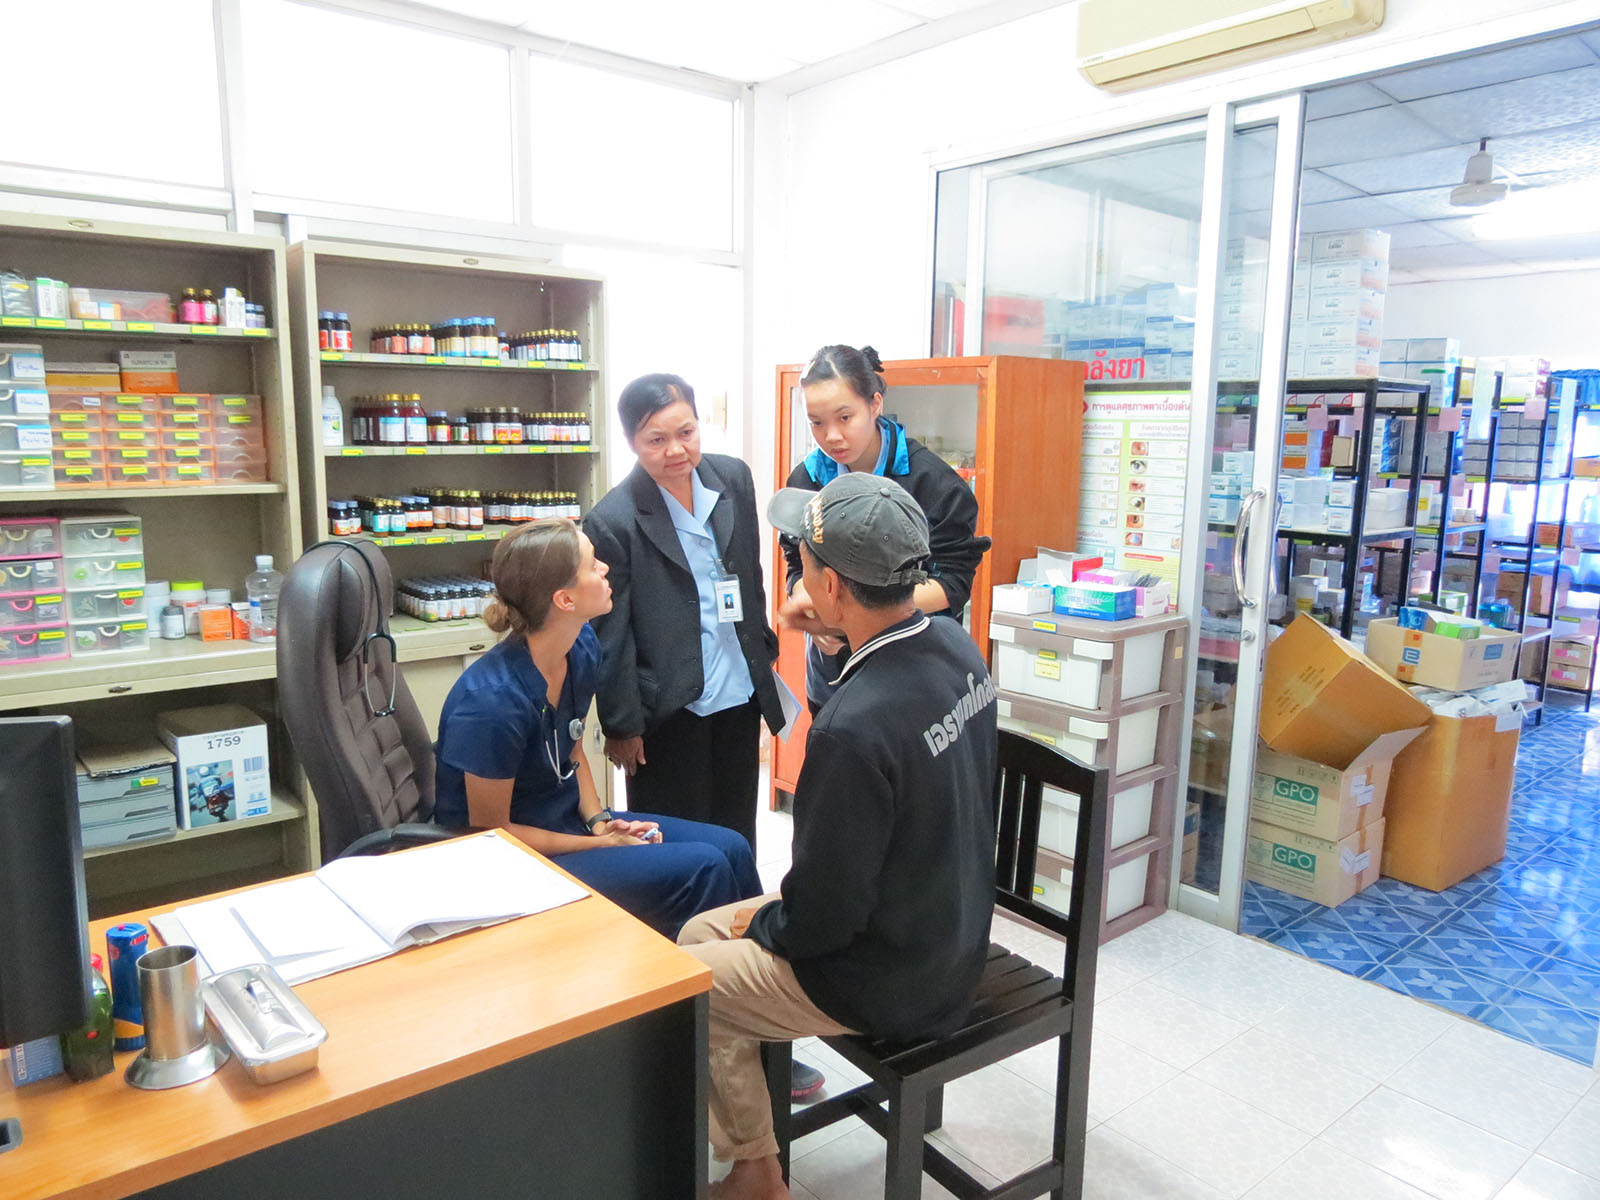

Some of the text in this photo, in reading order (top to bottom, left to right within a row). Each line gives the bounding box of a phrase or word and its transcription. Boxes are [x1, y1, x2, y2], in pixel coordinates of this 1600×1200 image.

[207, 736, 241, 750] 1759
[1275, 780, 1316, 802] GPO
[1273, 847, 1313, 869] GPO
